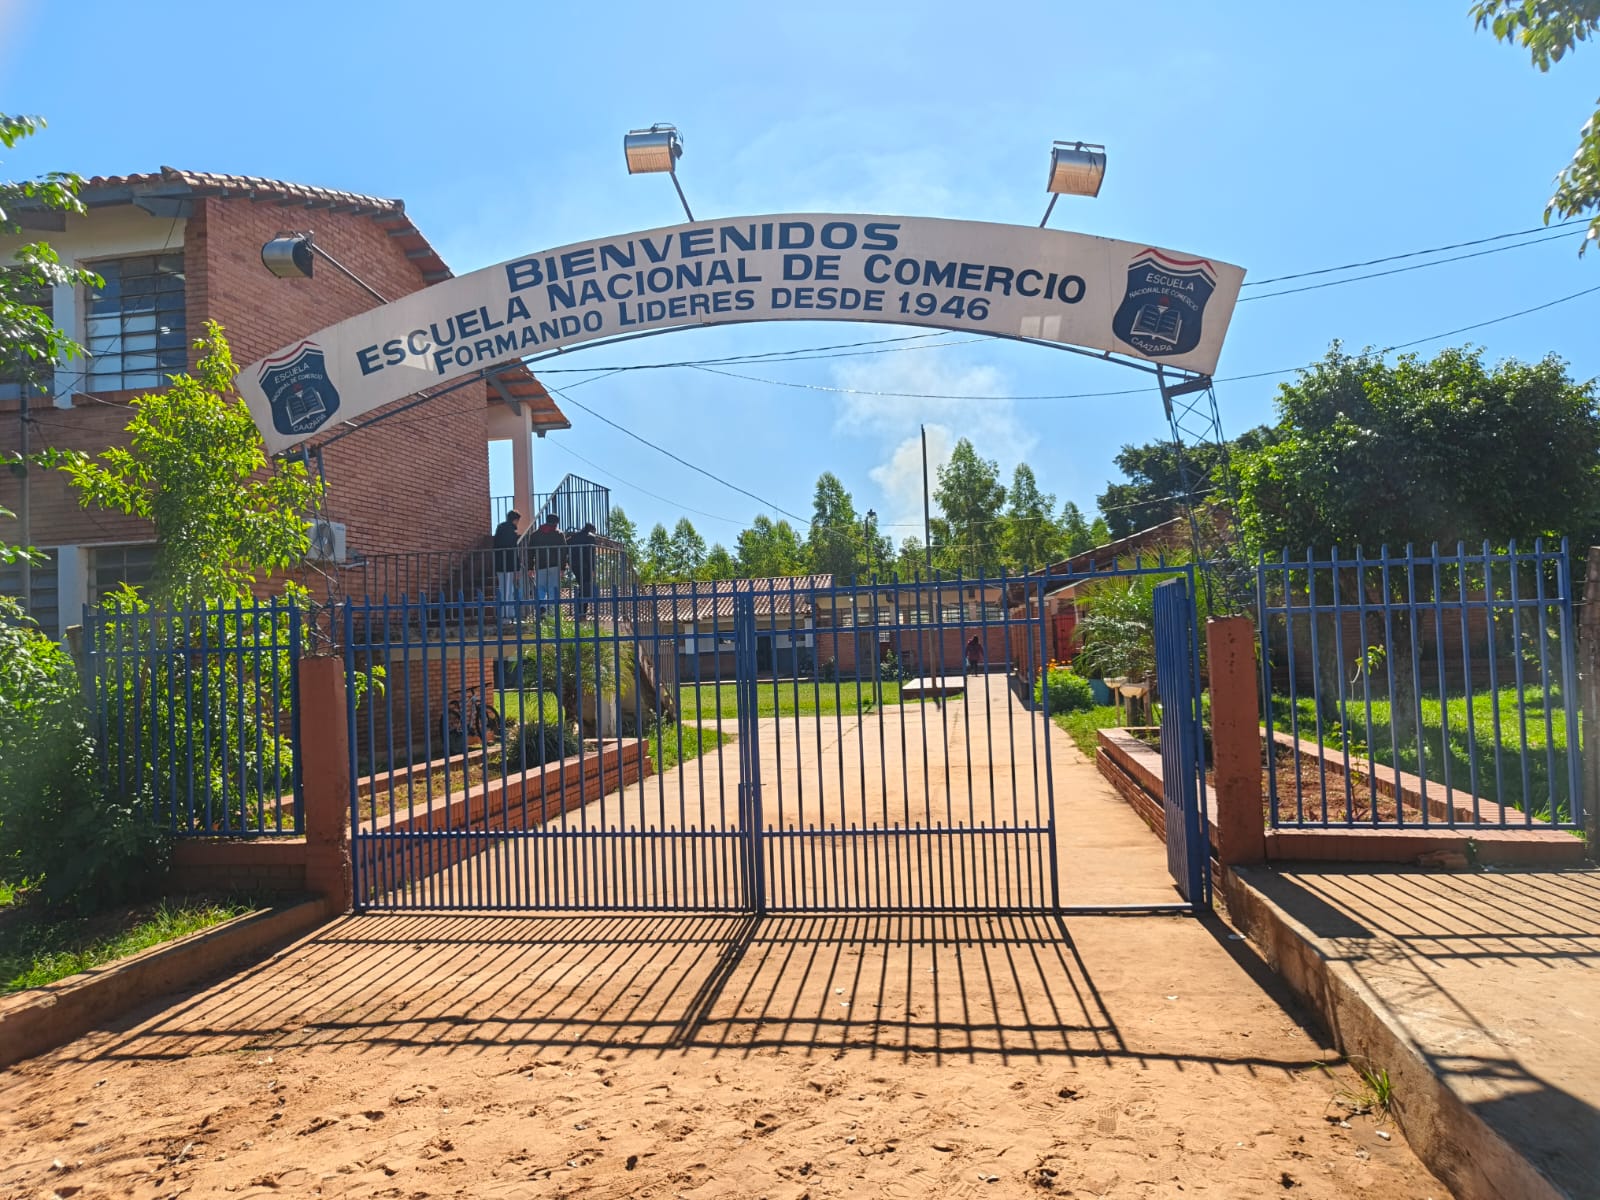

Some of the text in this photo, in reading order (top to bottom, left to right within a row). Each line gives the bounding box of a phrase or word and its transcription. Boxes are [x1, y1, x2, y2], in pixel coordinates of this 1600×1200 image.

[506, 222, 901, 293] BIENVENIDOS
[1129, 287, 1199, 311] NACIONAL DE COMERCIO
[1145, 273, 1194, 292] ESCUELA
[356, 254, 1086, 376] ESCUELA NACIONAL DE COMERCIO
[432, 310, 604, 376] FORMANDO
[618, 288, 755, 326] LIDERES
[770, 287, 886, 311] DESDE
[274, 362, 310, 384] ESCUELA
